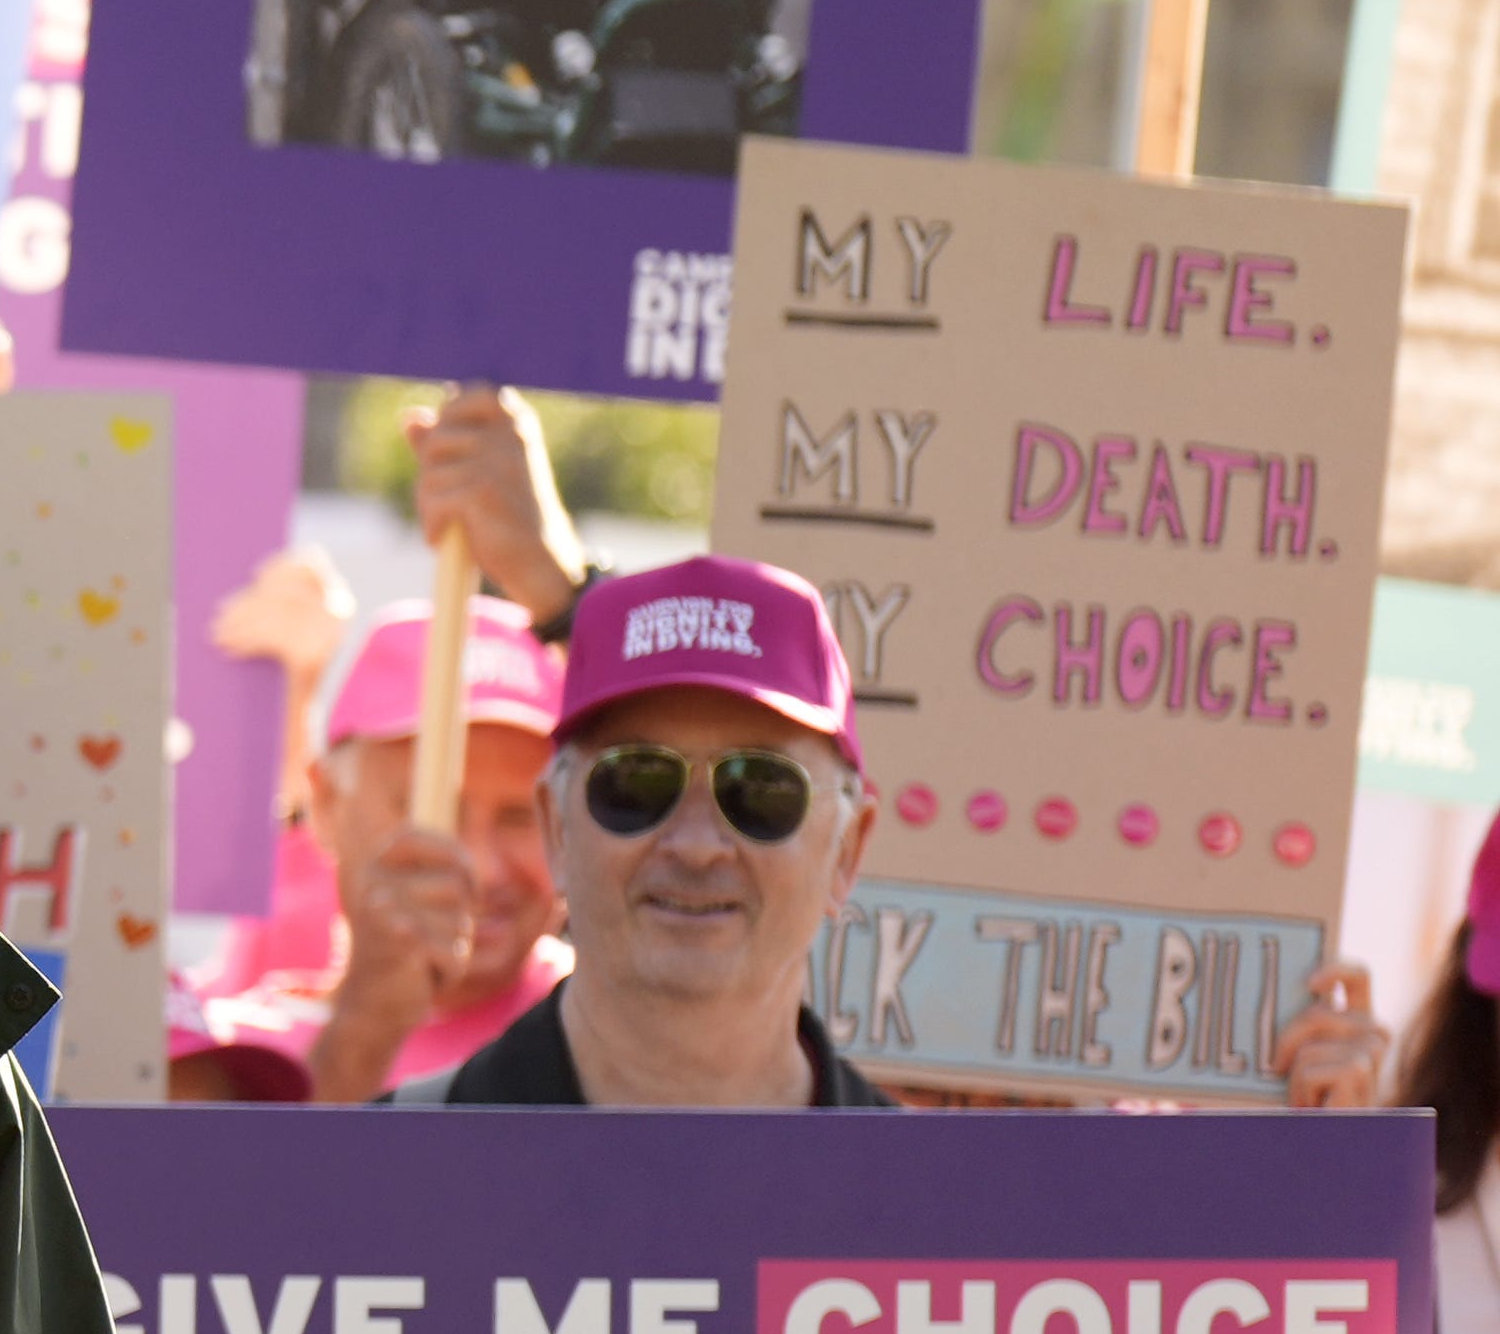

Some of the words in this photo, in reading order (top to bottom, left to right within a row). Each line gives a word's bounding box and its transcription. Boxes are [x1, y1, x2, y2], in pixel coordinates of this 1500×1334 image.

[795, 205, 951, 308] MY
[1040, 234, 1333, 350] LIFE.
[773, 398, 937, 508] MY
[1007, 419, 1339, 561] DEATH.
[821, 579, 911, 684] Y
[975, 594, 1329, 727] CHOICE.
[802, 900, 936, 1051] CK
[974, 913, 1122, 1066] THE
